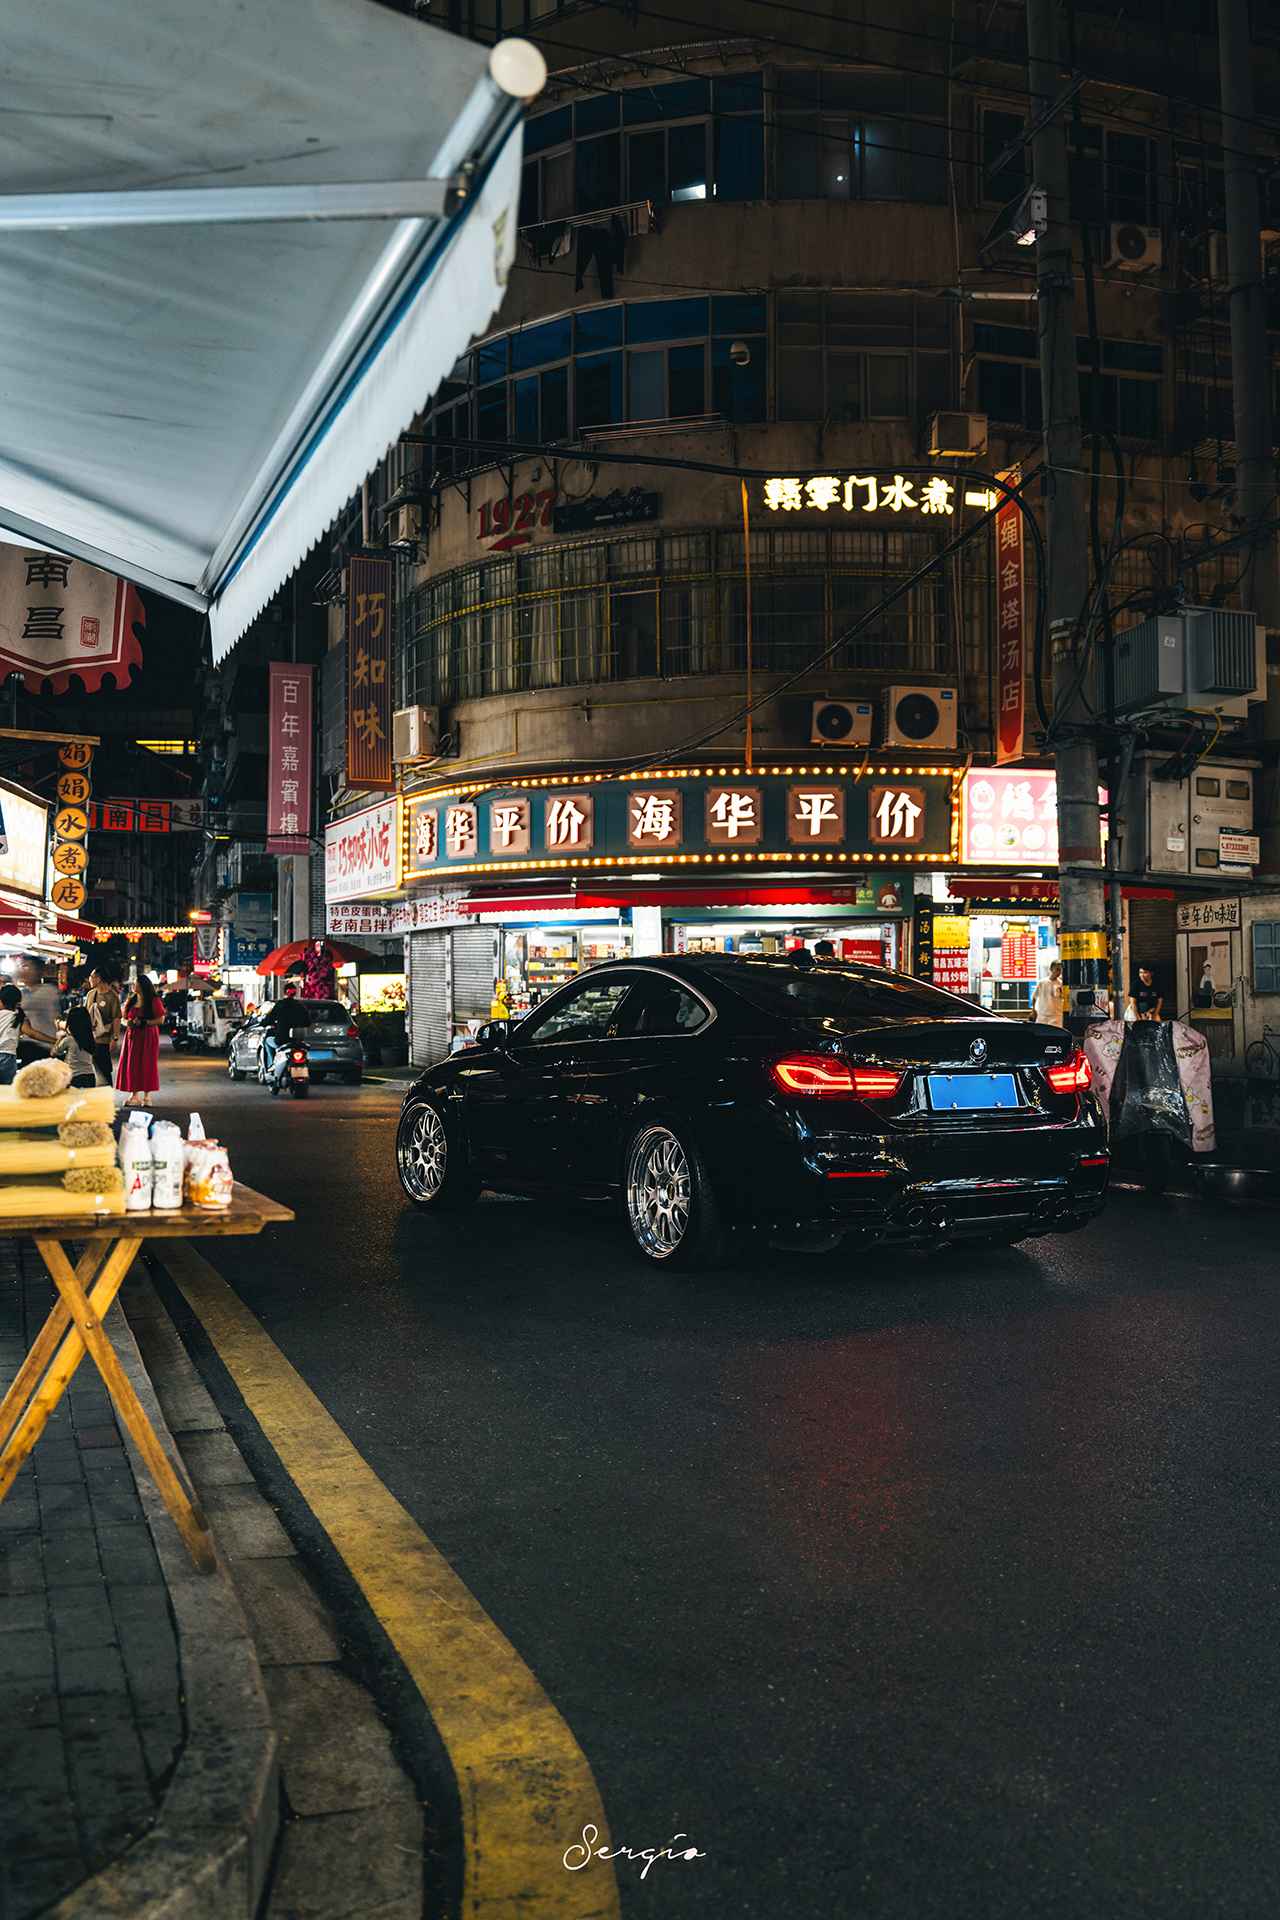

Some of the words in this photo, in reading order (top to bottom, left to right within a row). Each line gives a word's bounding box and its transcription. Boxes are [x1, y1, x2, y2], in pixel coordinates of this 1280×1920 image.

[476, 489, 558, 540] 1927
[21, 553, 74, 640] 南昌
[1001, 516, 1020, 712] 绳金塔汤店
[353, 592, 386, 751] 巧知味
[57, 742, 88, 904] 娟娟水煮店
[338, 821, 392, 877] 巧知味小吃
[415, 799, 585, 857] 海华平价
[631, 790, 922, 841] 海华平价
[1180, 903, 1237, 928] 童年的味道
